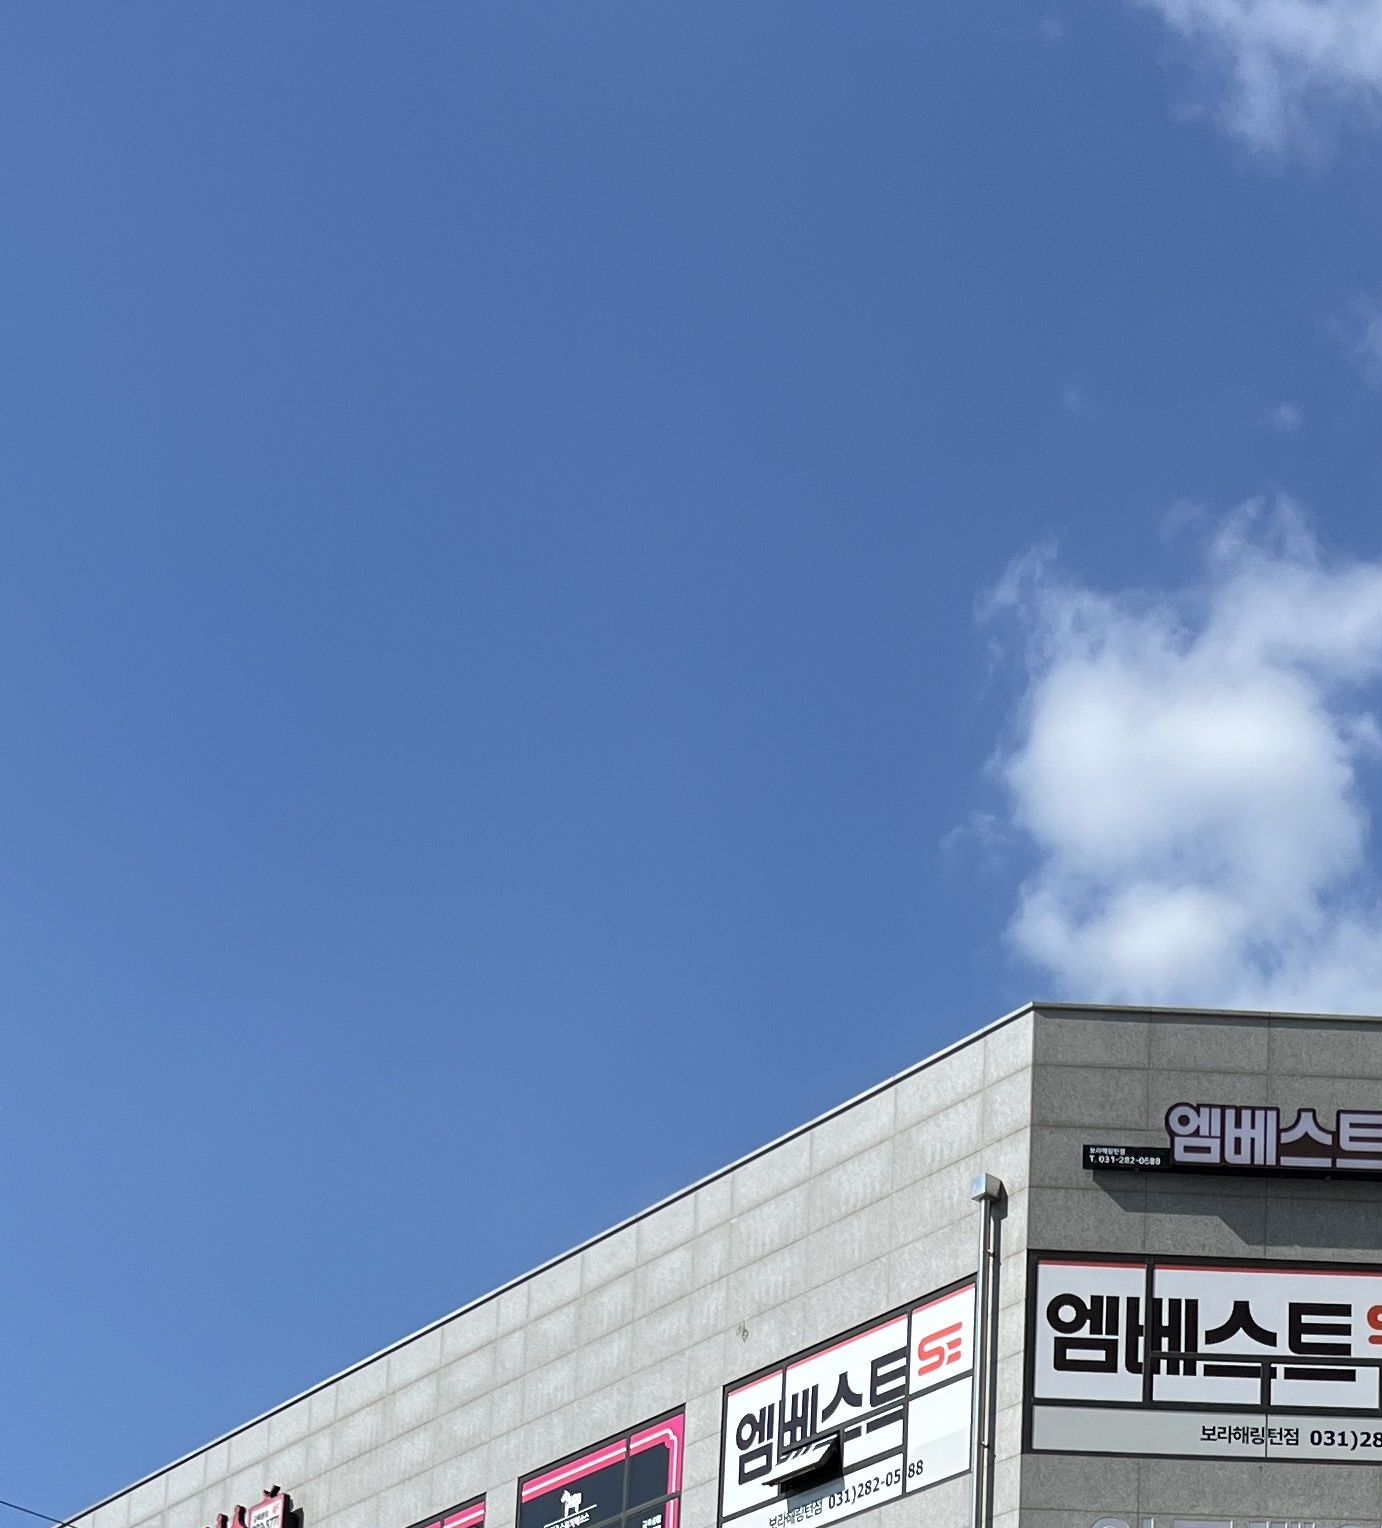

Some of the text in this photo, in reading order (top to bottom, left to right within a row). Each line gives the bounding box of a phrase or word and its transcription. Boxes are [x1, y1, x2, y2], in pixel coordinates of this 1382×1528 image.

[1046, 1293, 1357, 1382] 엠베스트
[736, 1346, 908, 1485] 엠베스트
[1200, 1424, 1300, 1447] 보라해링턴점
[828, 1460, 924, 1509] 031)282-0588
